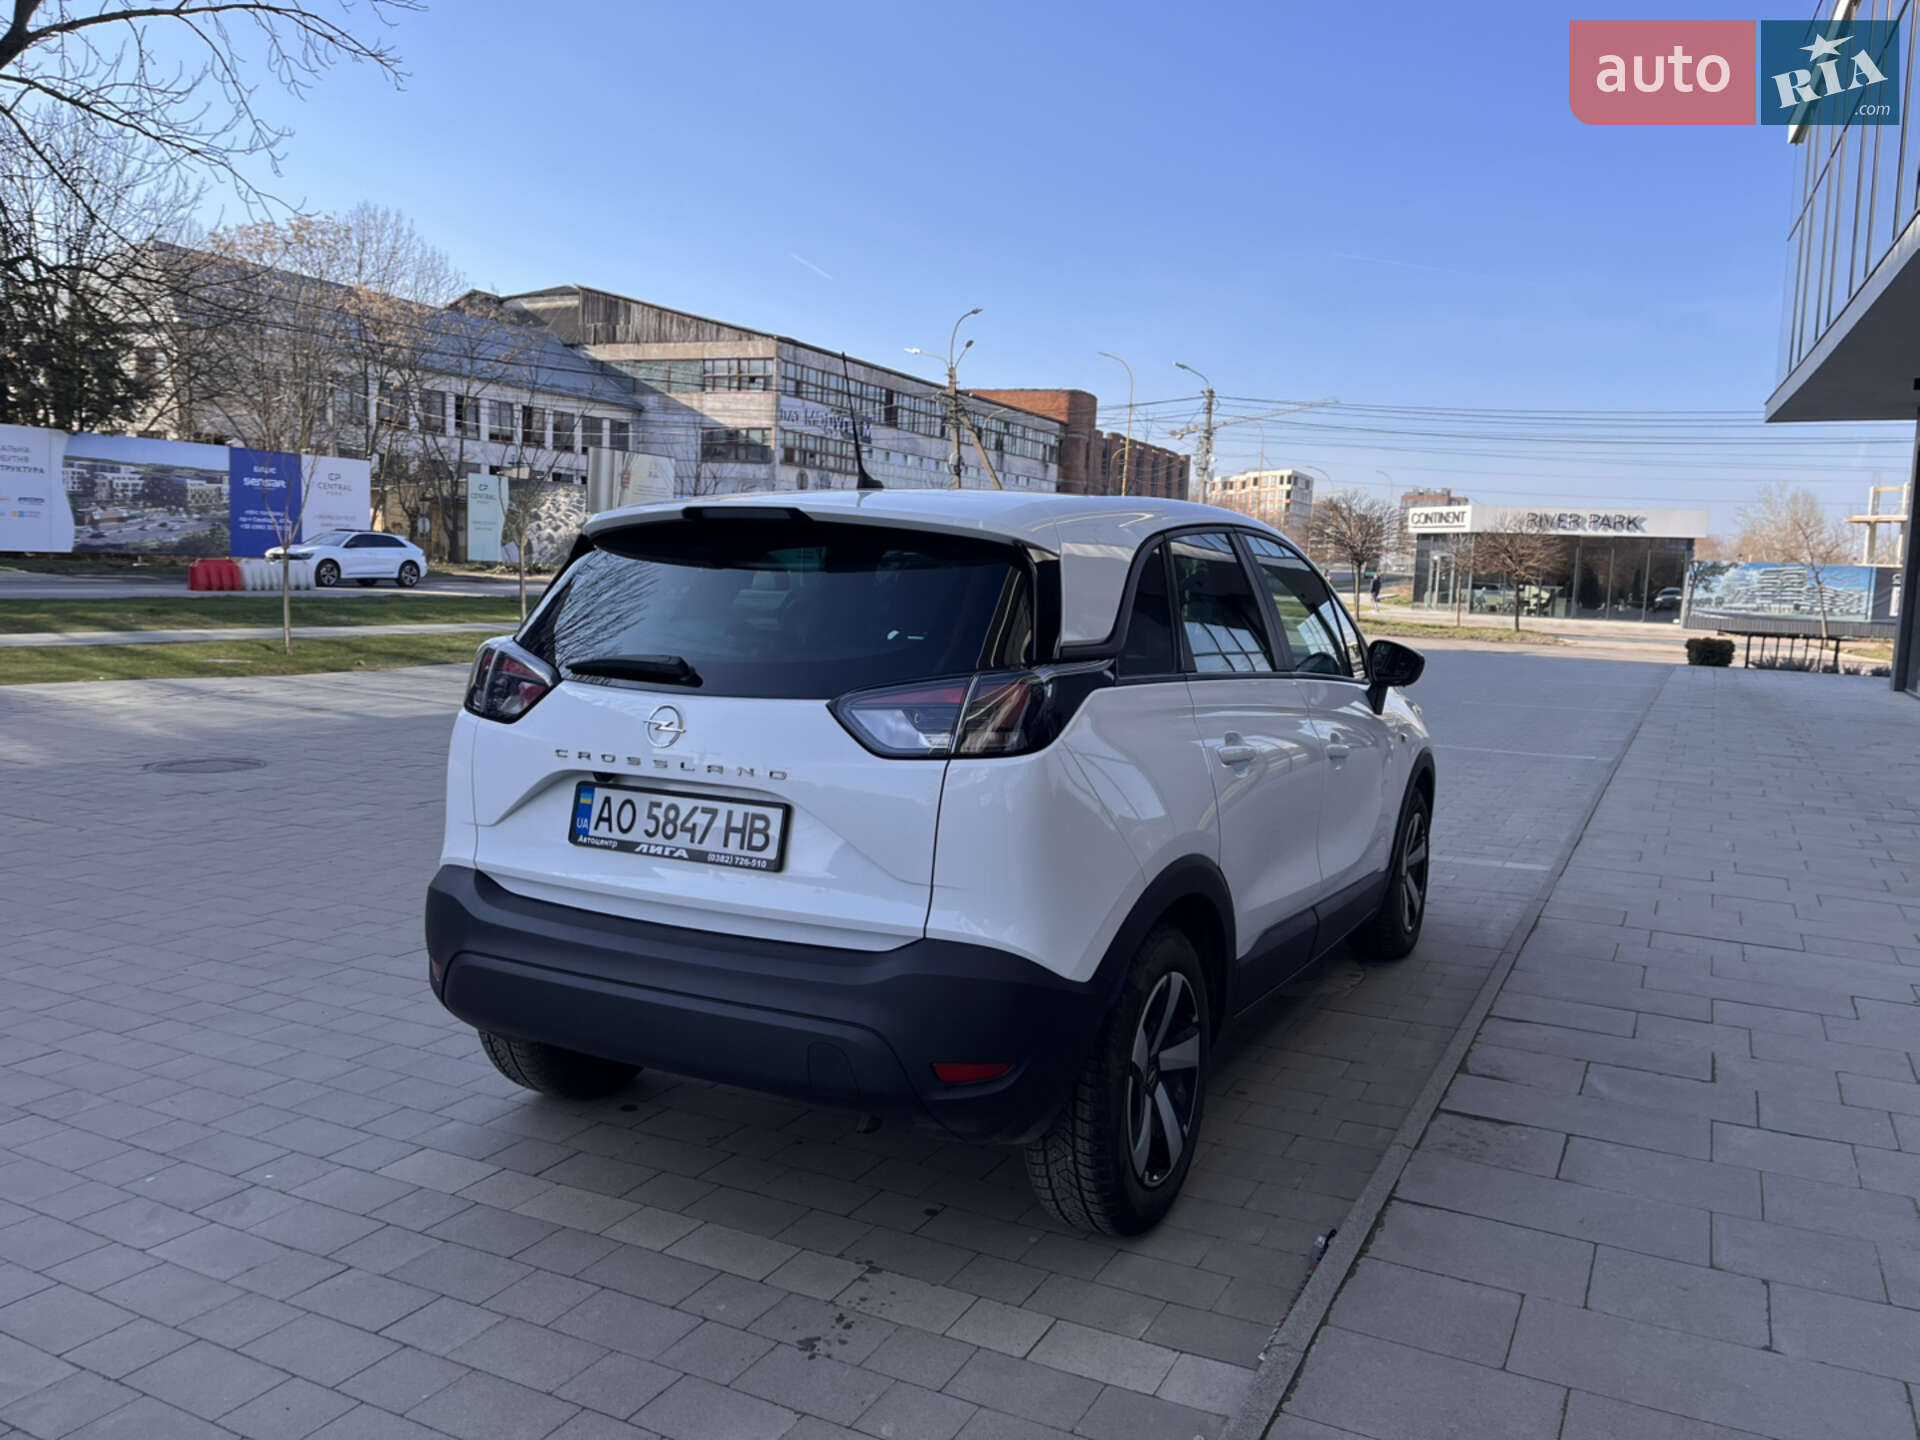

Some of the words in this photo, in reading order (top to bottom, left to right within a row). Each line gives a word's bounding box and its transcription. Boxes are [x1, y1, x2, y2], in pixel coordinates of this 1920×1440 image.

[317, 481, 353, 492] CENTRAL
[1410, 510, 1467, 525] CONTINENT
[1526, 512, 1580, 529] RIVER
[1588, 513, 1642, 531] PARK
[555, 749, 788, 780] CROSSLAND
[576, 817, 589, 830] UA
[593, 795, 637, 835] AO
[643, 801, 719, 845] 5847
[722, 809, 771, 852] HB
[577, 835, 618, 849] Автоцентр
[634, 844, 689, 859] ЛИГА
